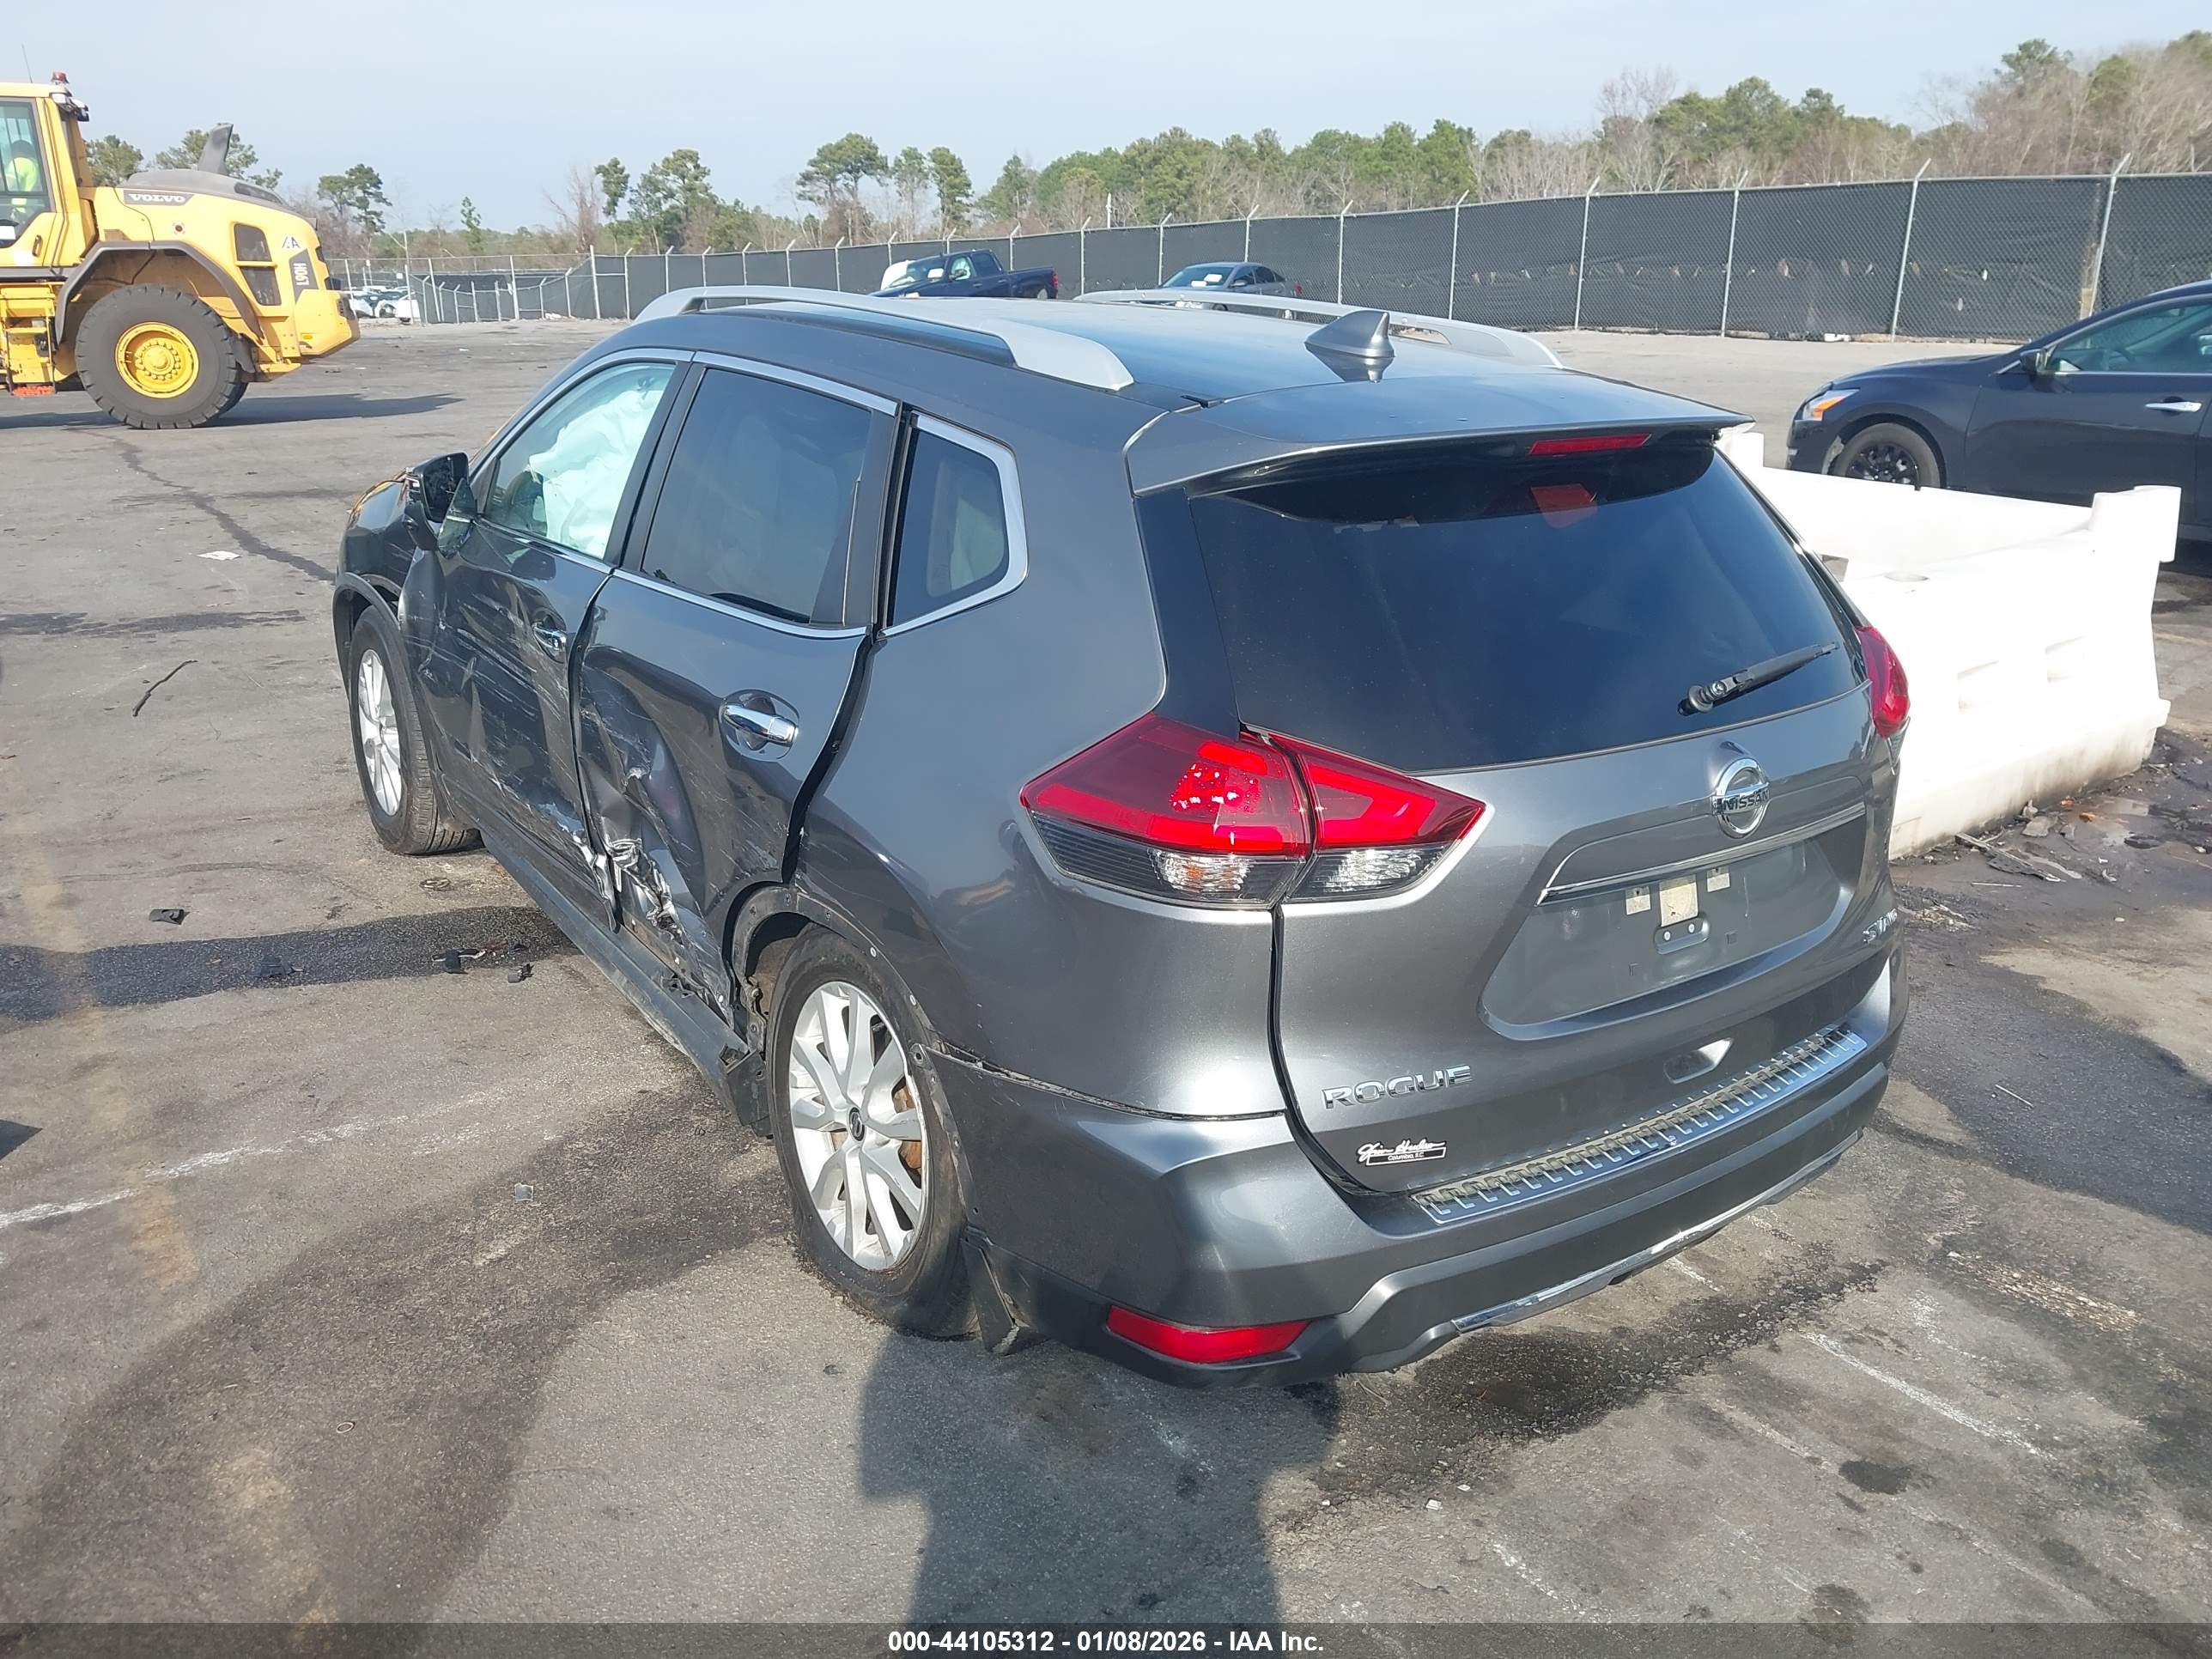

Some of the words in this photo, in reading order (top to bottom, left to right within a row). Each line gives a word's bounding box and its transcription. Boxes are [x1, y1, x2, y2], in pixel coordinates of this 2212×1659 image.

[128, 193, 186, 204] VOLVO
[293, 263, 310, 286] L90H
[1723, 787, 1771, 811] NISSAN
[1322, 1064, 1472, 1109] ROGUE
